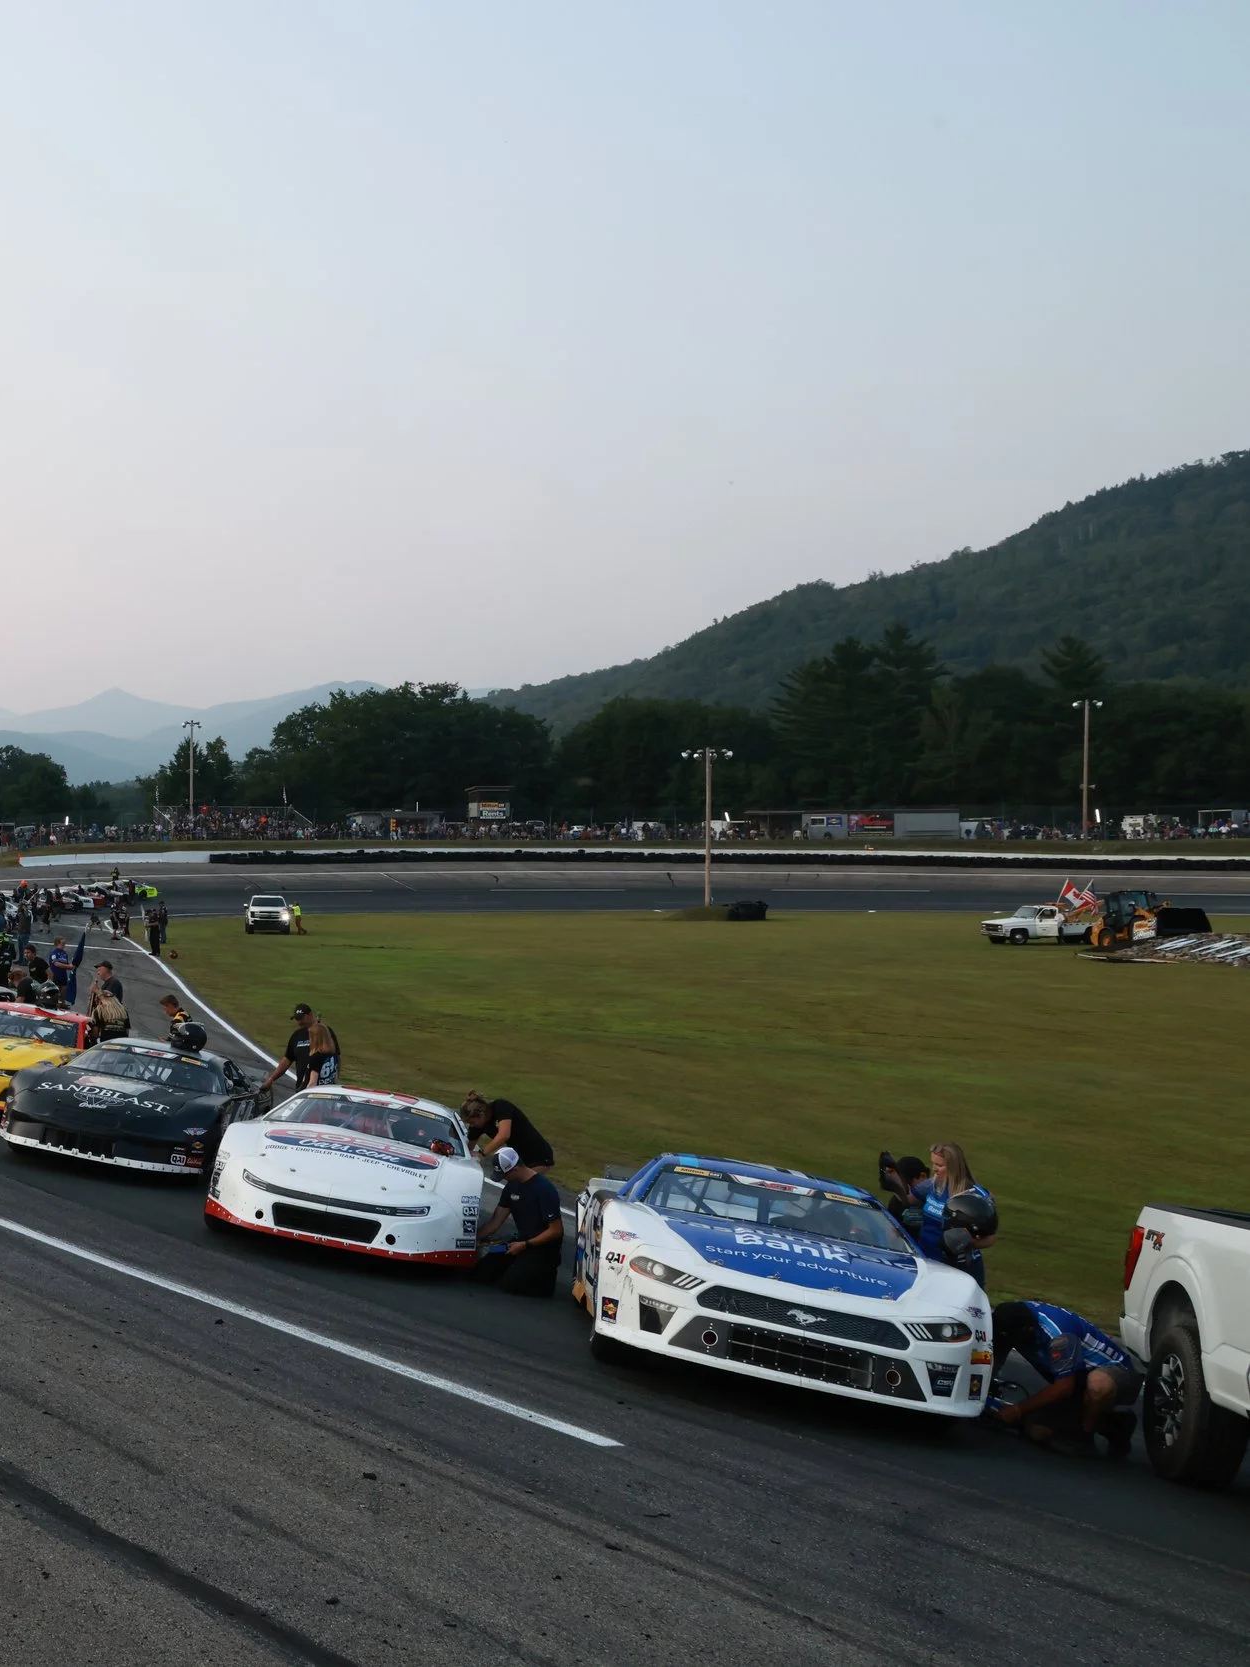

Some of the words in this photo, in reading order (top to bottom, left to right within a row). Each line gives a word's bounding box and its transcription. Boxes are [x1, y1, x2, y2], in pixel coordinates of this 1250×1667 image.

[36, 1081, 171, 1115] SANDBLAST
[295, 1146, 333, 1156] CHRYSLER
[339, 1152, 355, 1160] RAM
[361, 1157, 381, 1166] JEEP
[386, 1163, 428, 1181] CHEVROLET
[298, 1138, 400, 1164] Cars.com
[463, 1207, 478, 1216] QA1
[605, 1251, 626, 1264] QA1
[734, 1233, 851, 1265] Bank
[705, 1245, 748, 1258] Start
[752, 1252, 791, 1266] your
[796, 1260, 892, 1288] adventure.
